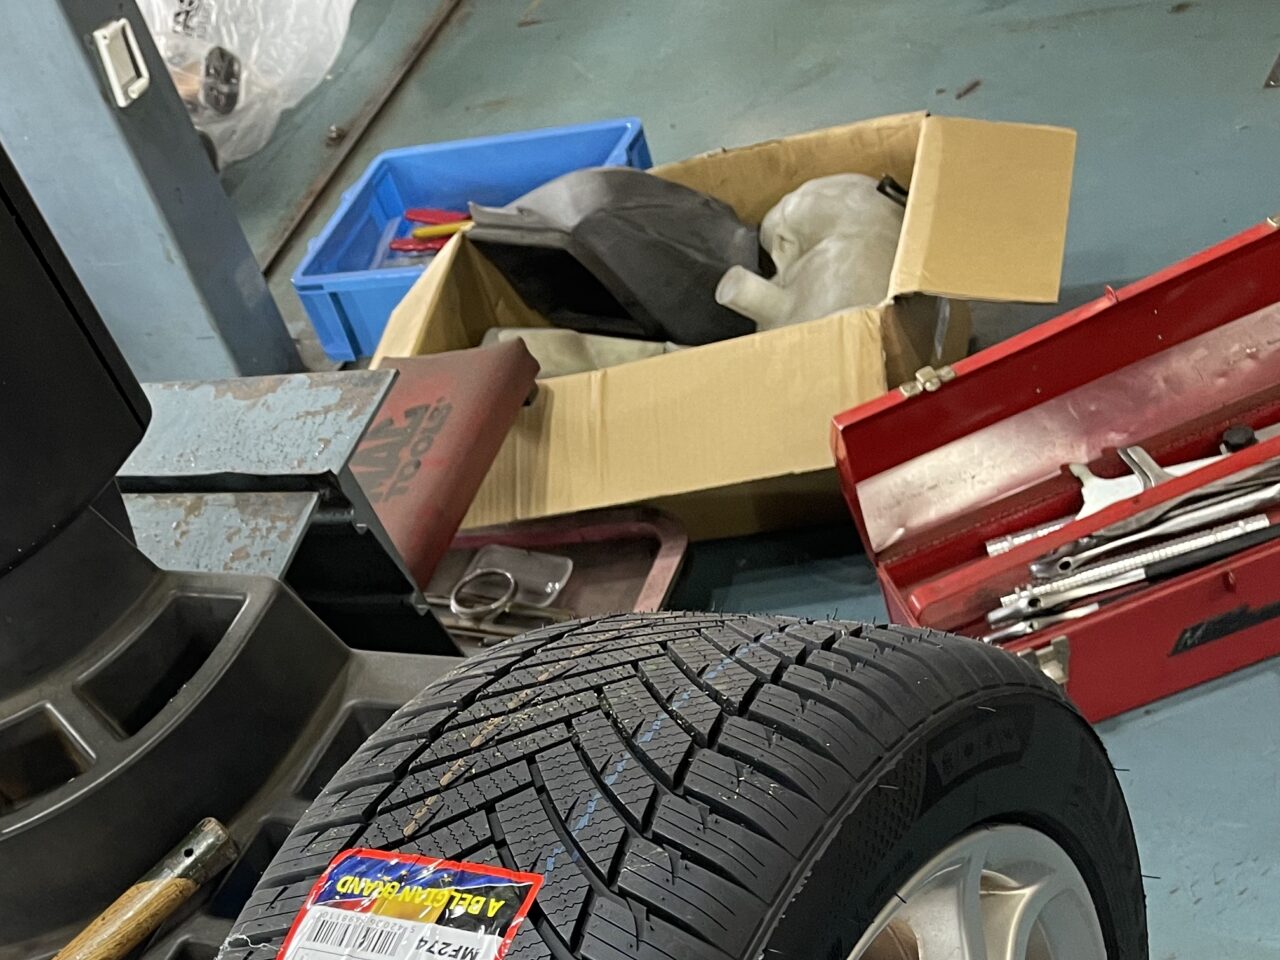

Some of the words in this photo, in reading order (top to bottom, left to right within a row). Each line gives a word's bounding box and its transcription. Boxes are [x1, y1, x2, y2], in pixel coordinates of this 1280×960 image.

[336, 875, 400, 901] BRAND
[398, 885, 487, 915] BELGIAN
[486, 899, 505, 918] A
